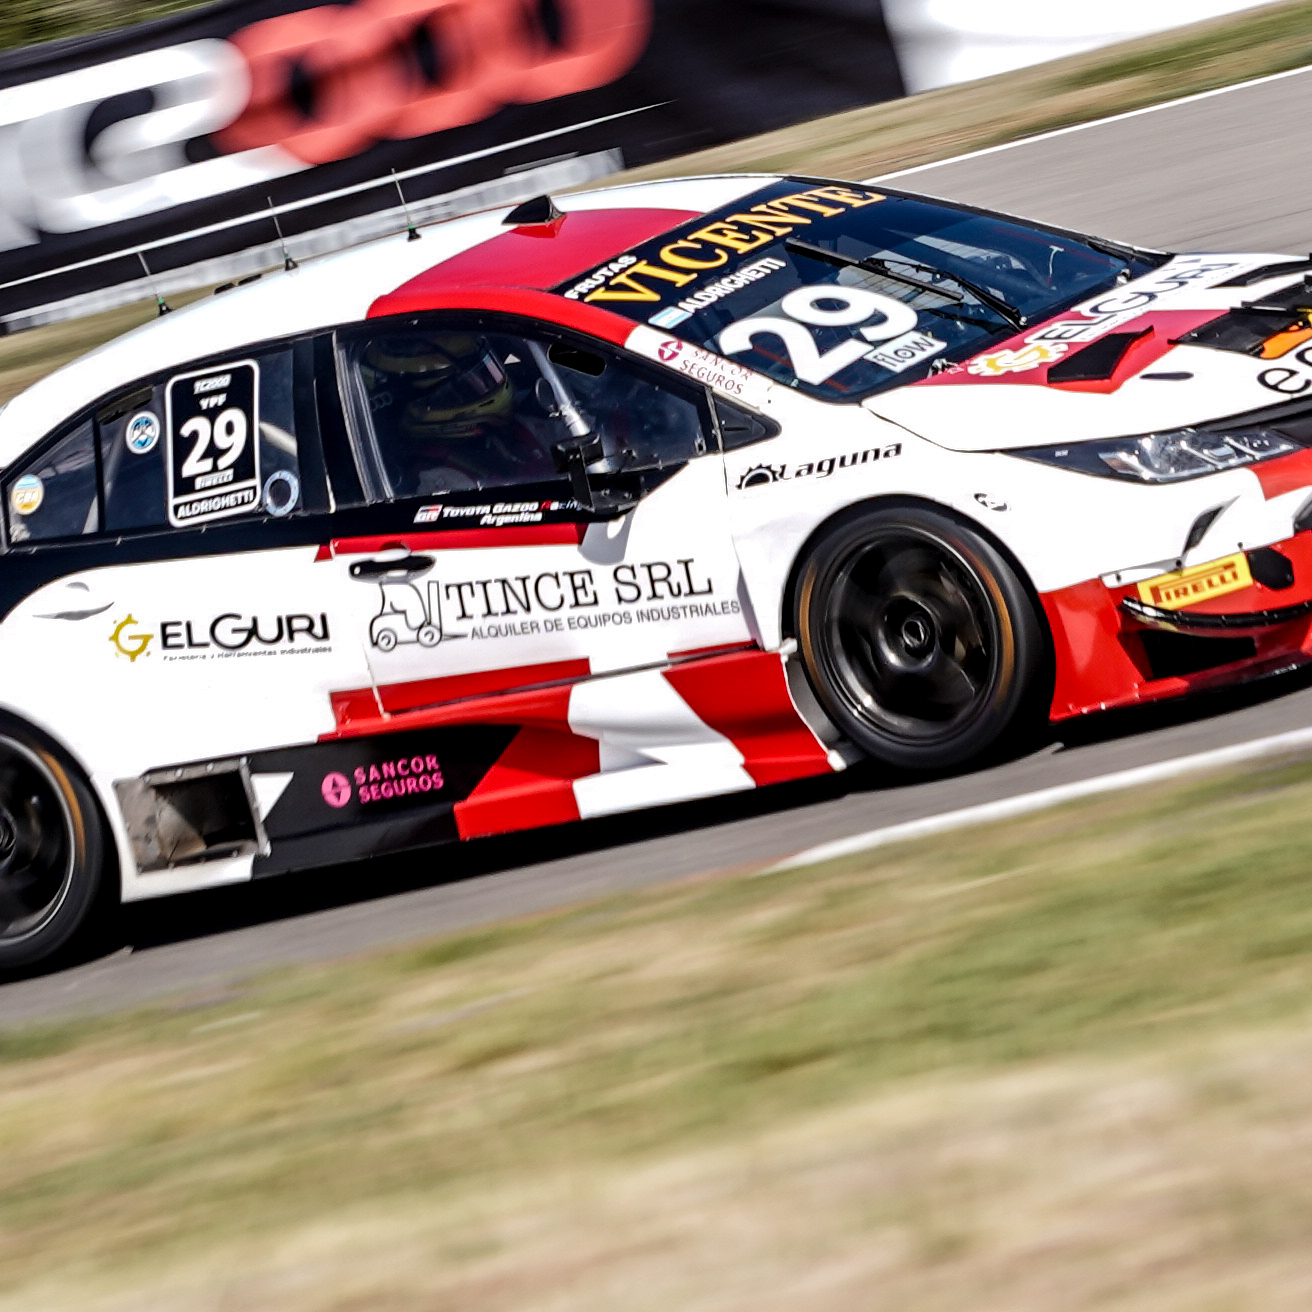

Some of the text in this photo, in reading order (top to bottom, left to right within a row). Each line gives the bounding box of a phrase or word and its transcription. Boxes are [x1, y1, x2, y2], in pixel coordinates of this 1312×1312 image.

[583, 185, 887, 303] VICENTE
[563, 255, 638, 301] FRUTAS
[677, 257, 787, 315] ALDRIGHETTI
[718, 284, 920, 386] 29
[679, 359, 744, 395] SEGUROS
[179, 407, 247, 478] 29
[177, 489, 254, 519] ALDRIGHETTI
[443, 506, 491, 518] TOYOTA
[492, 502, 539, 513] GAZOO
[479, 512, 543, 526] Argentina
[445, 558, 714, 620] TINCE SRL
[1150, 562, 1239, 606] PIRELLI
[160, 613, 331, 650] ELGURI
[471, 600, 741, 640] ALQUILER DE EQUIPOS INDUSTRIALES
[354, 754, 440, 786] SANCOR
[359, 771, 444, 804] SEGUROS
